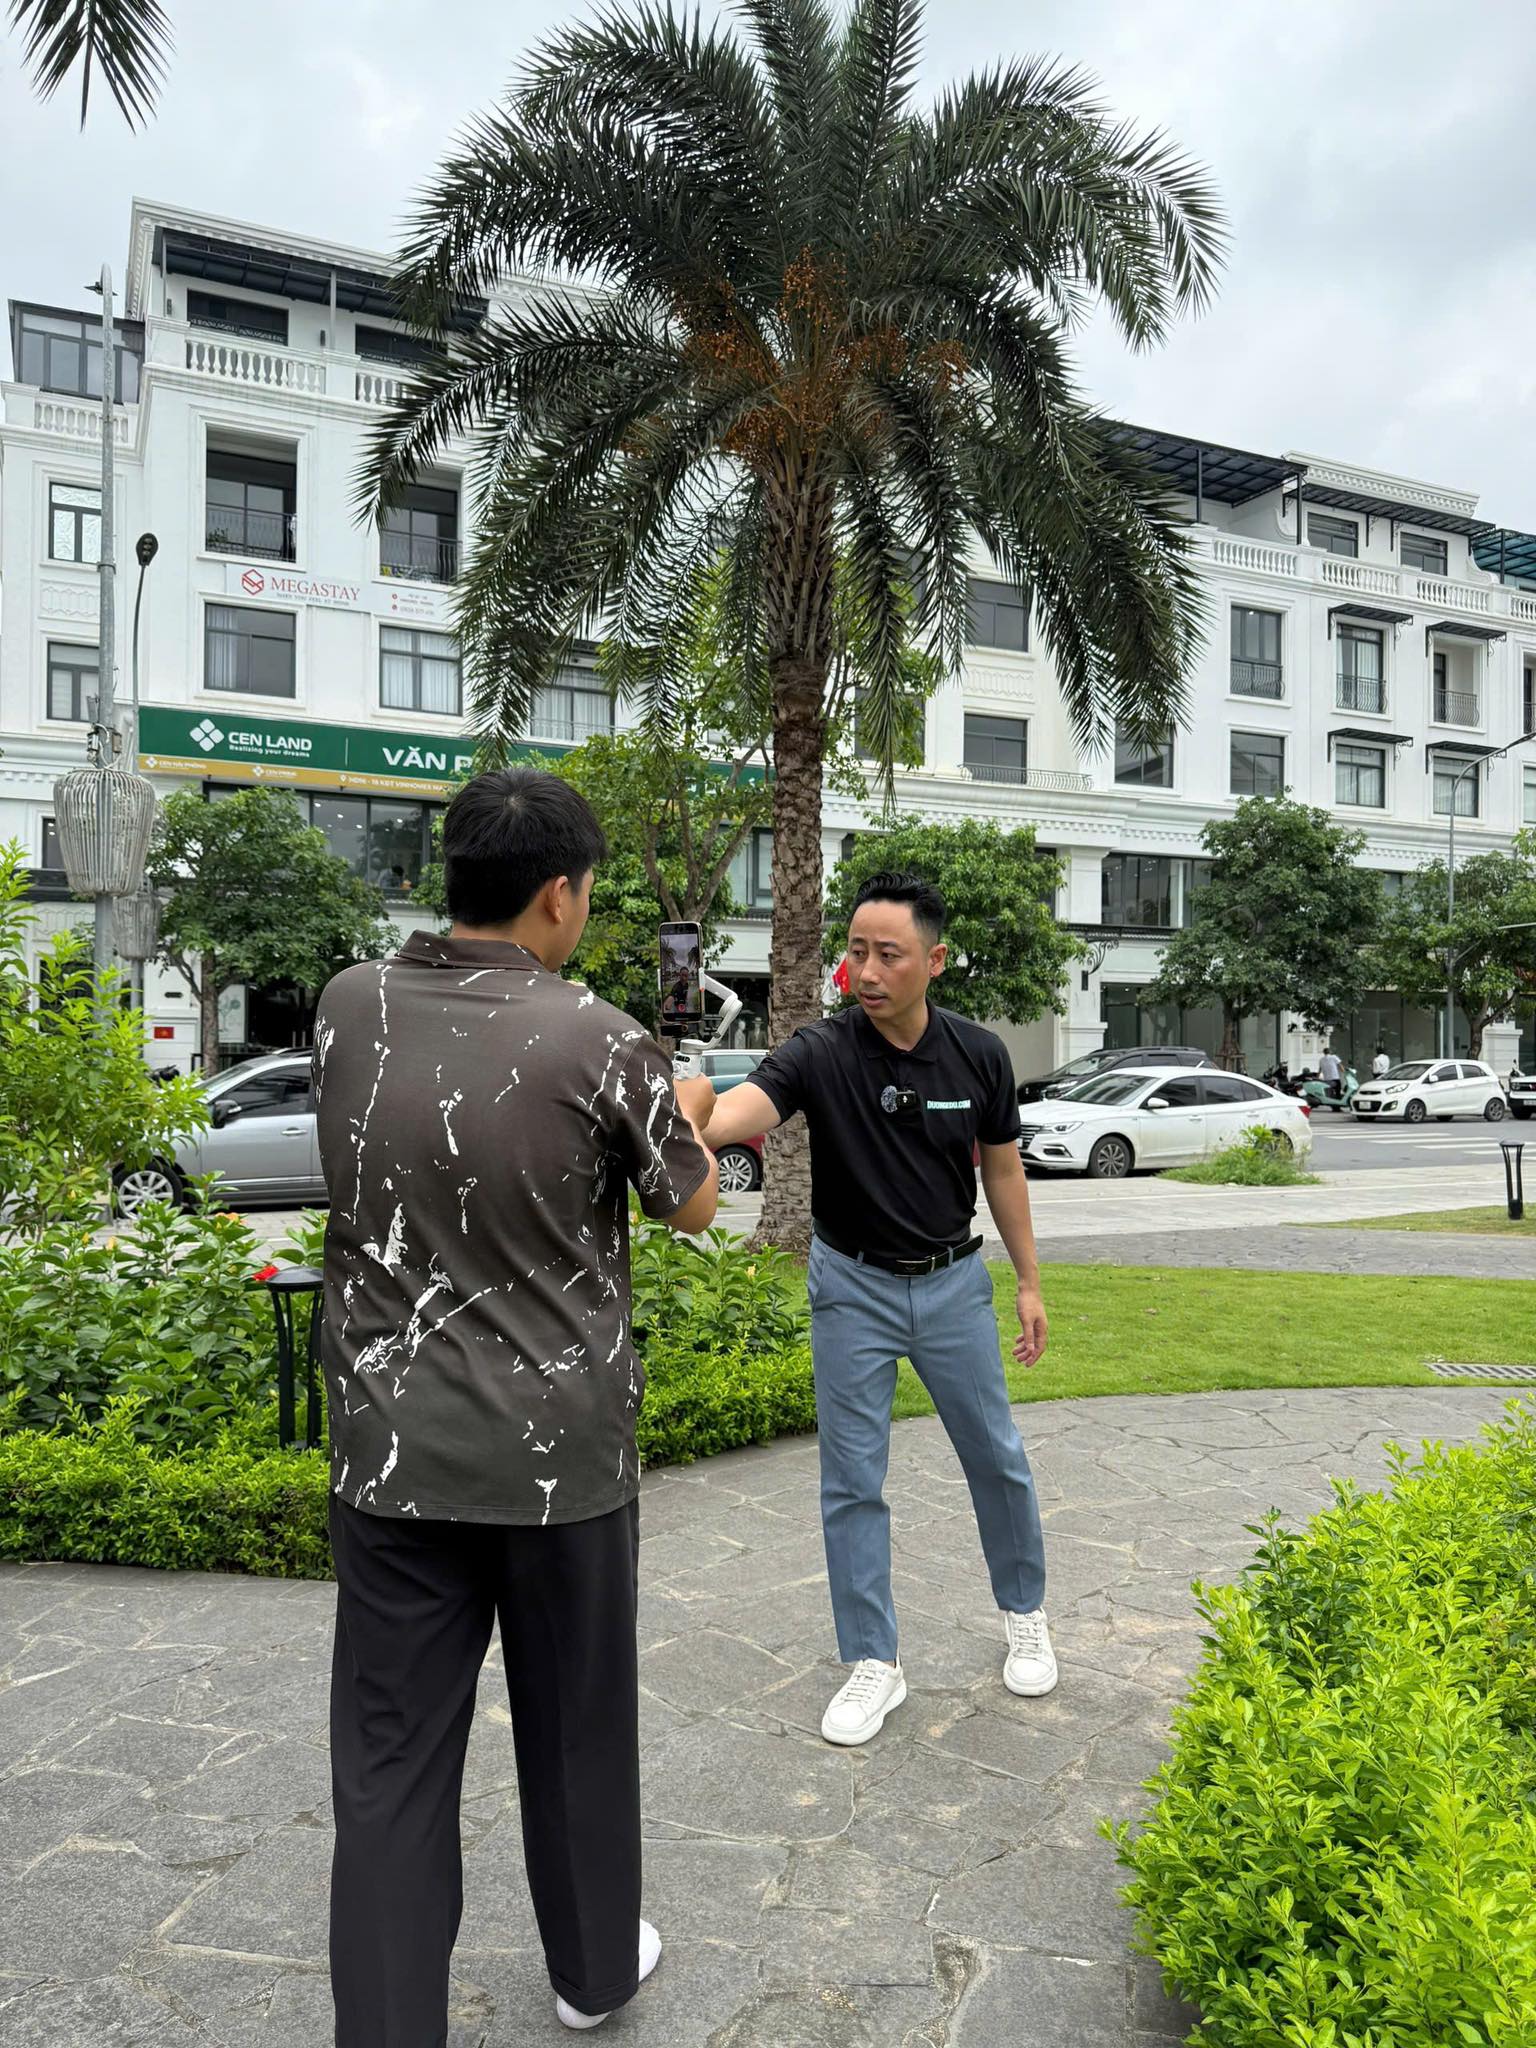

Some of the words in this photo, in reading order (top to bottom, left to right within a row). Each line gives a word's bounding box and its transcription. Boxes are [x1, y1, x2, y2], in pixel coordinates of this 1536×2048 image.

[271, 576, 360, 601] MEGASTAY
[228, 731, 263, 747] CEN
[266, 734, 313, 751] LAND
[265, 748, 282, 756] your
[382, 746, 447, 771] VĂN
